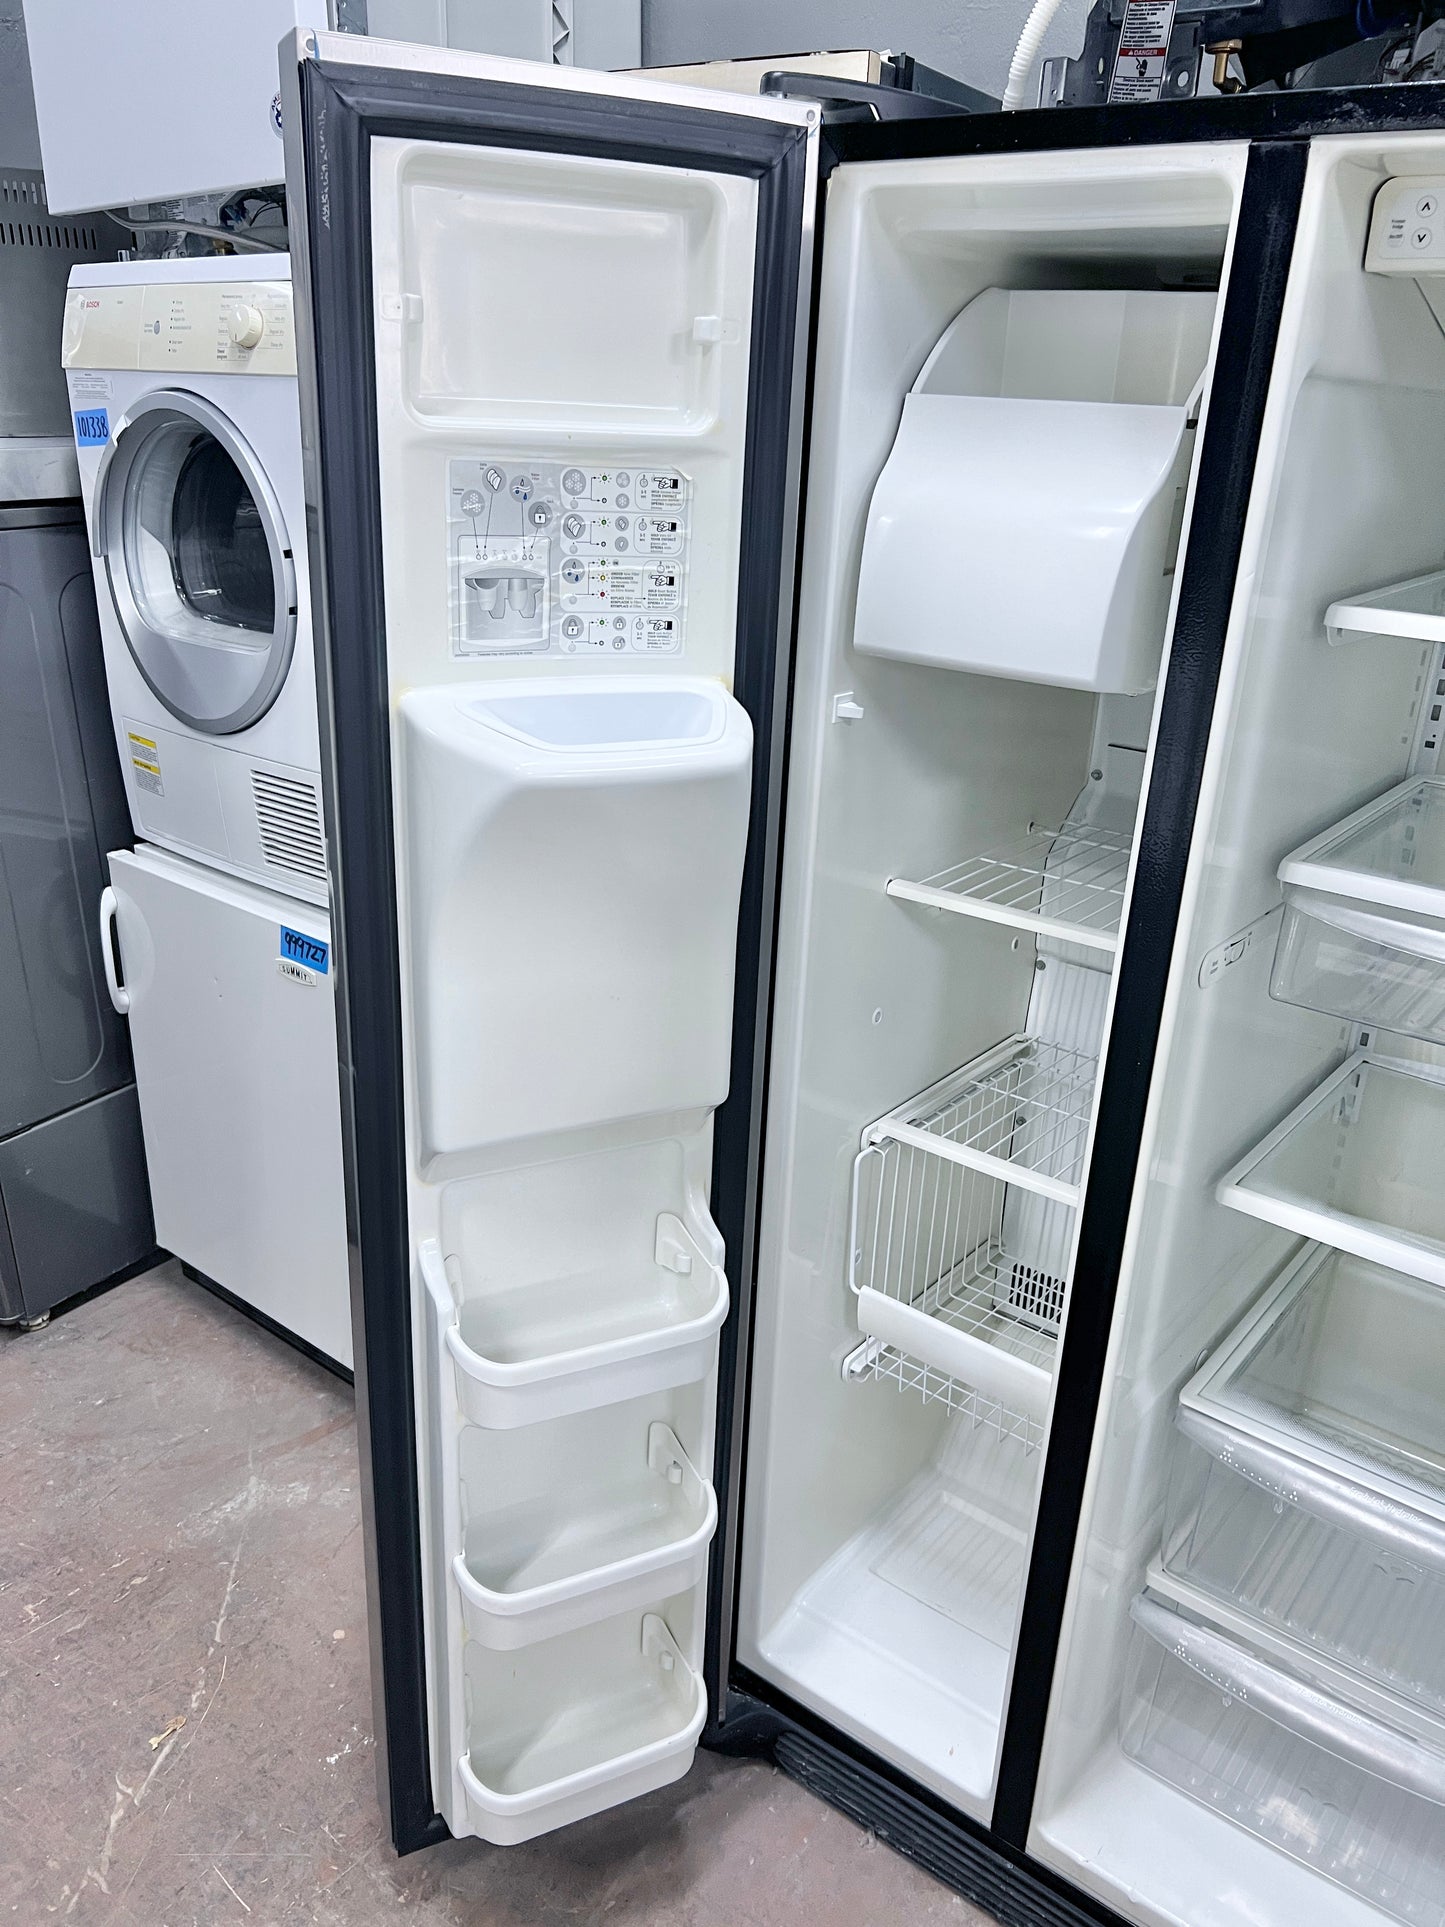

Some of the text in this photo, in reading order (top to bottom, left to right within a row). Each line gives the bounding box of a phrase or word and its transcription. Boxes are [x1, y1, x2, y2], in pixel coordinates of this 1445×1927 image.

[77, 415, 109, 439] 101338
[285, 931, 327, 965] 999727
[282, 965, 307, 981] SUMMIT
